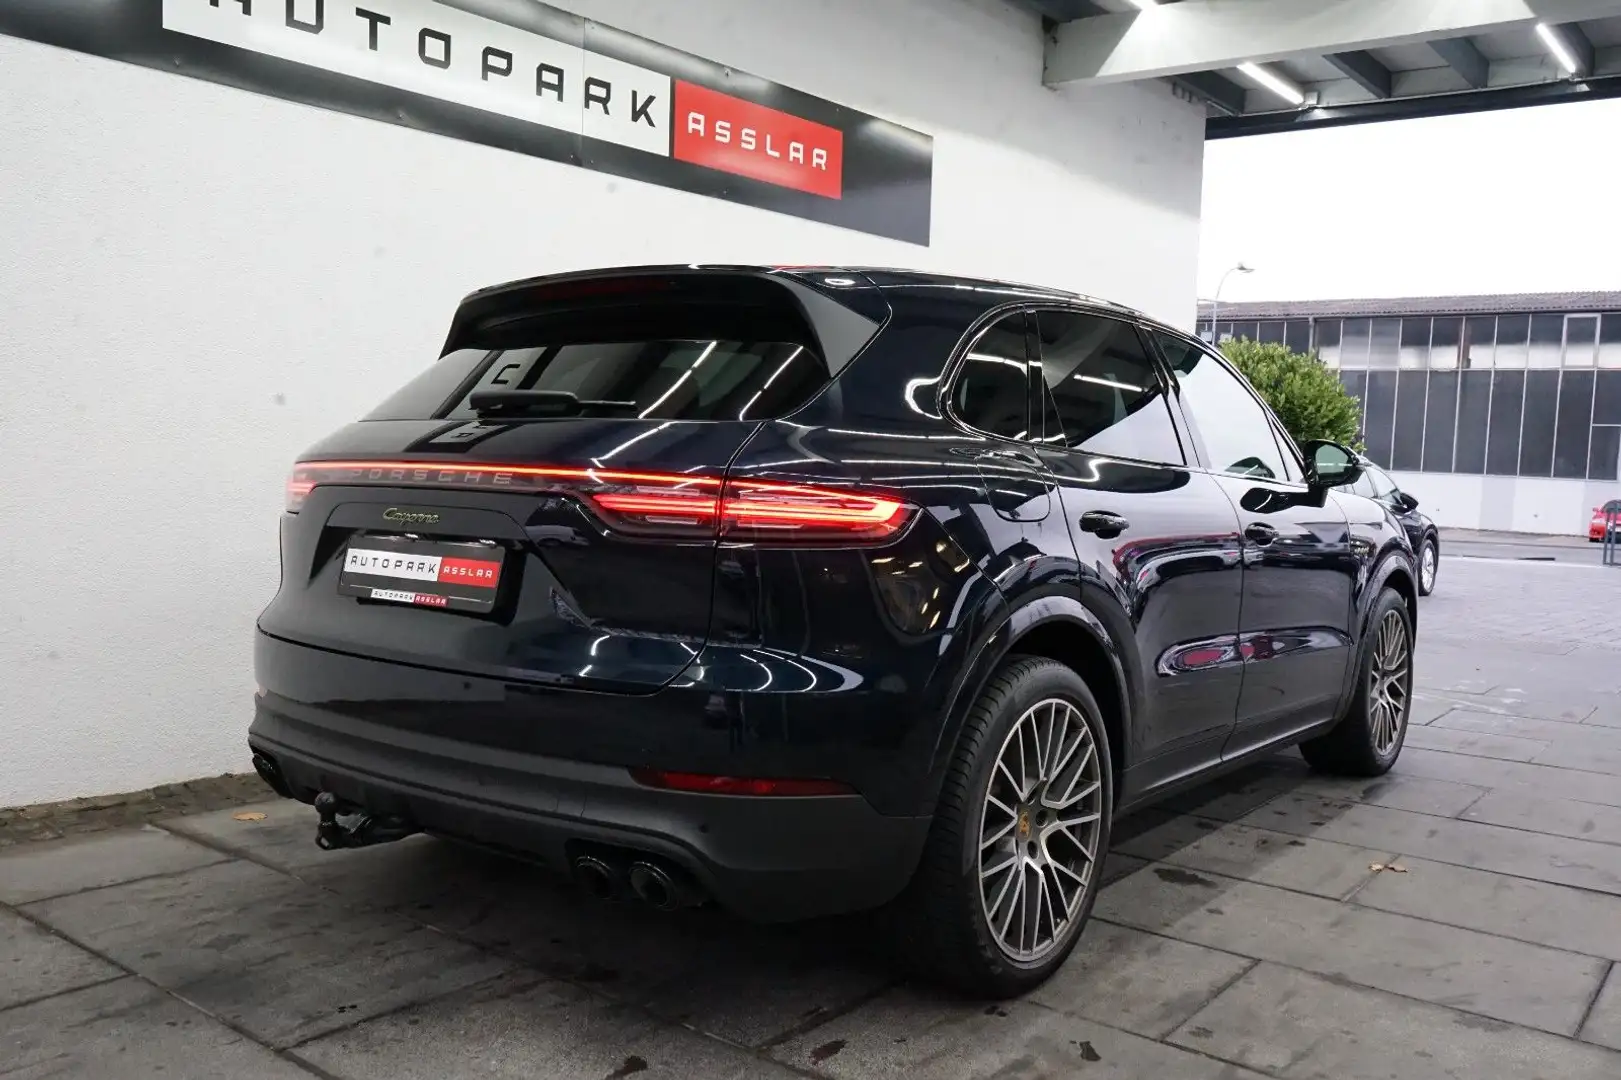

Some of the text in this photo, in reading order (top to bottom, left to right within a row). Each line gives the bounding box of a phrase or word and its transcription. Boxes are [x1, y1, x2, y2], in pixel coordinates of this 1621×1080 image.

[687, 111, 828, 170] ASSLAR
[350, 468, 513, 485] PORSCHE
[382, 507, 440, 525] Cayenne
[350, 555, 493, 579] AUTOPARK ASSLAR
[373, 590, 447, 605] AUTOPARK ASSLAR
